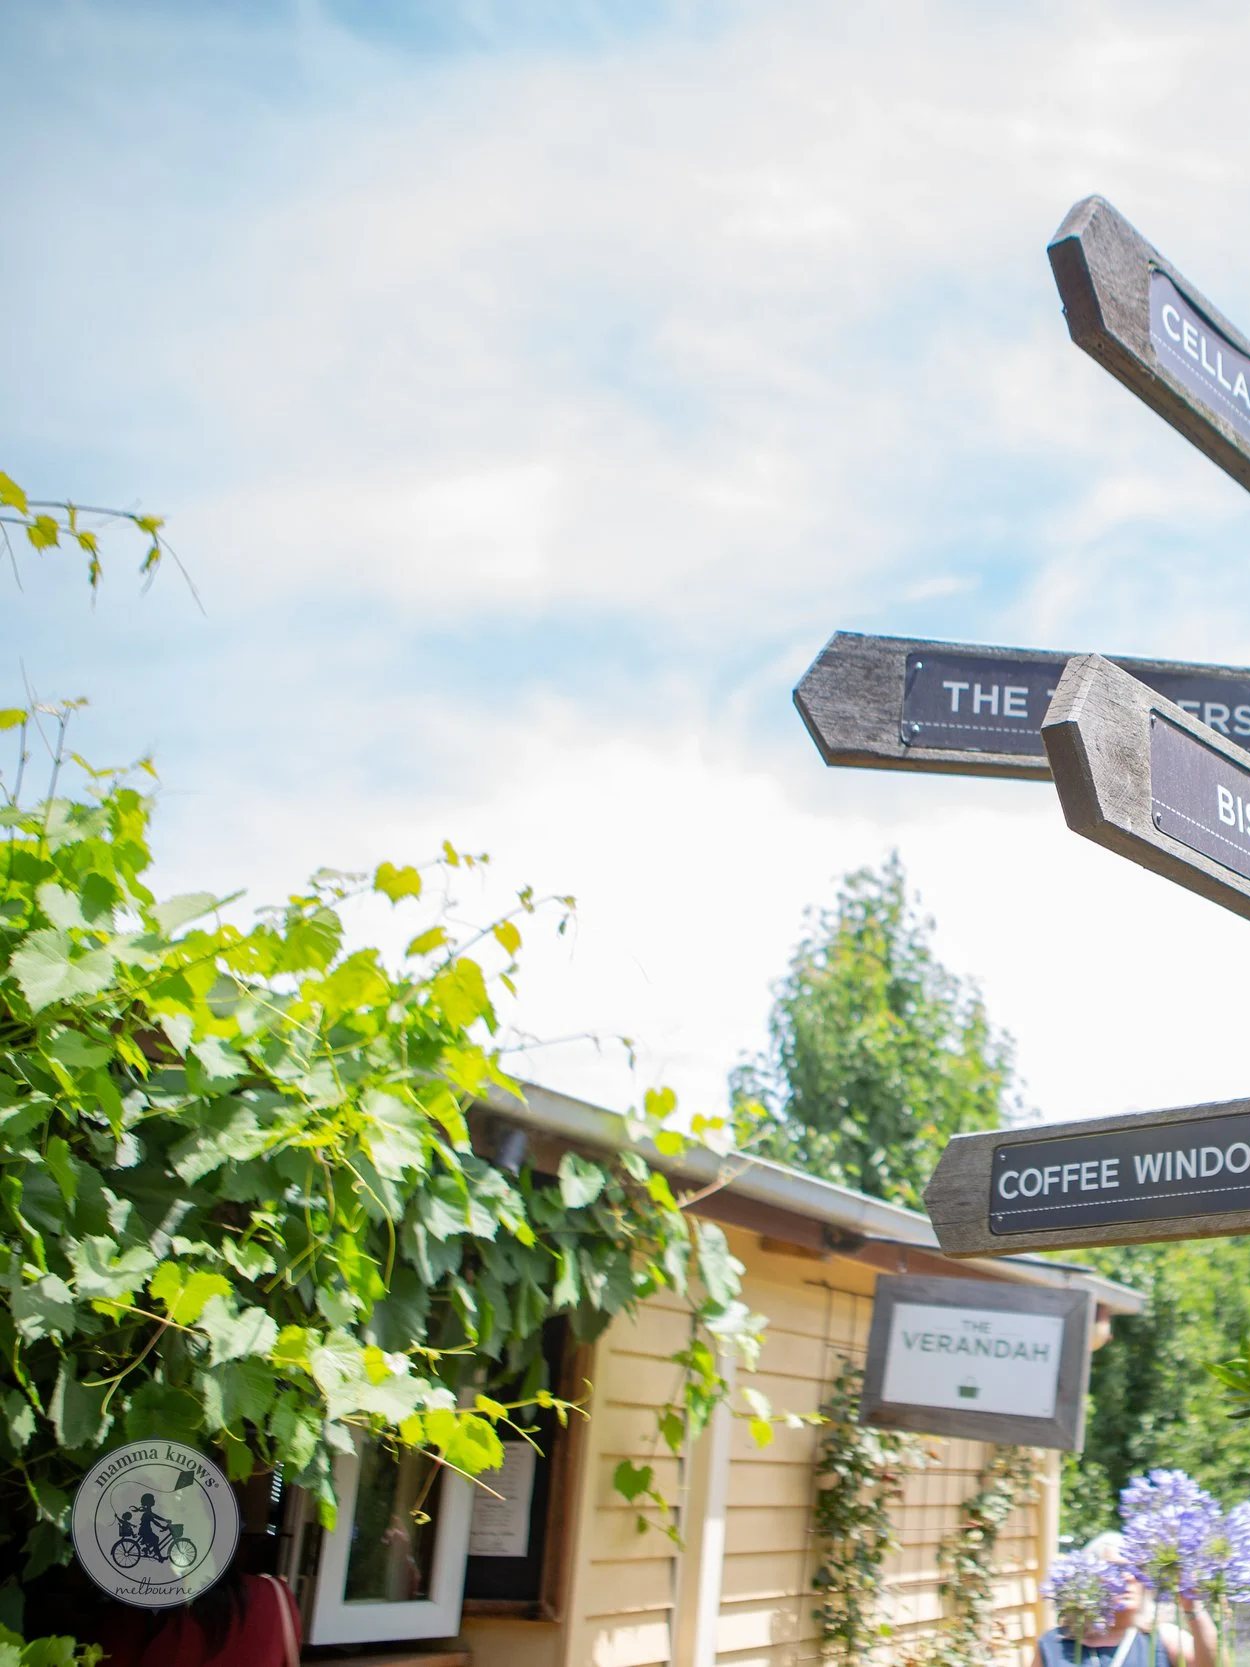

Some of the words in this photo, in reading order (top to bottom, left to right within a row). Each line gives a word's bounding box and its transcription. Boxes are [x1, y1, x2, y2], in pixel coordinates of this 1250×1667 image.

[942, 681, 1029, 718] THE
[998, 1158, 1120, 1201] COFFEE
[961, 1319, 993, 1335] THE
[902, 1331, 1050, 1363] VERANDAH
